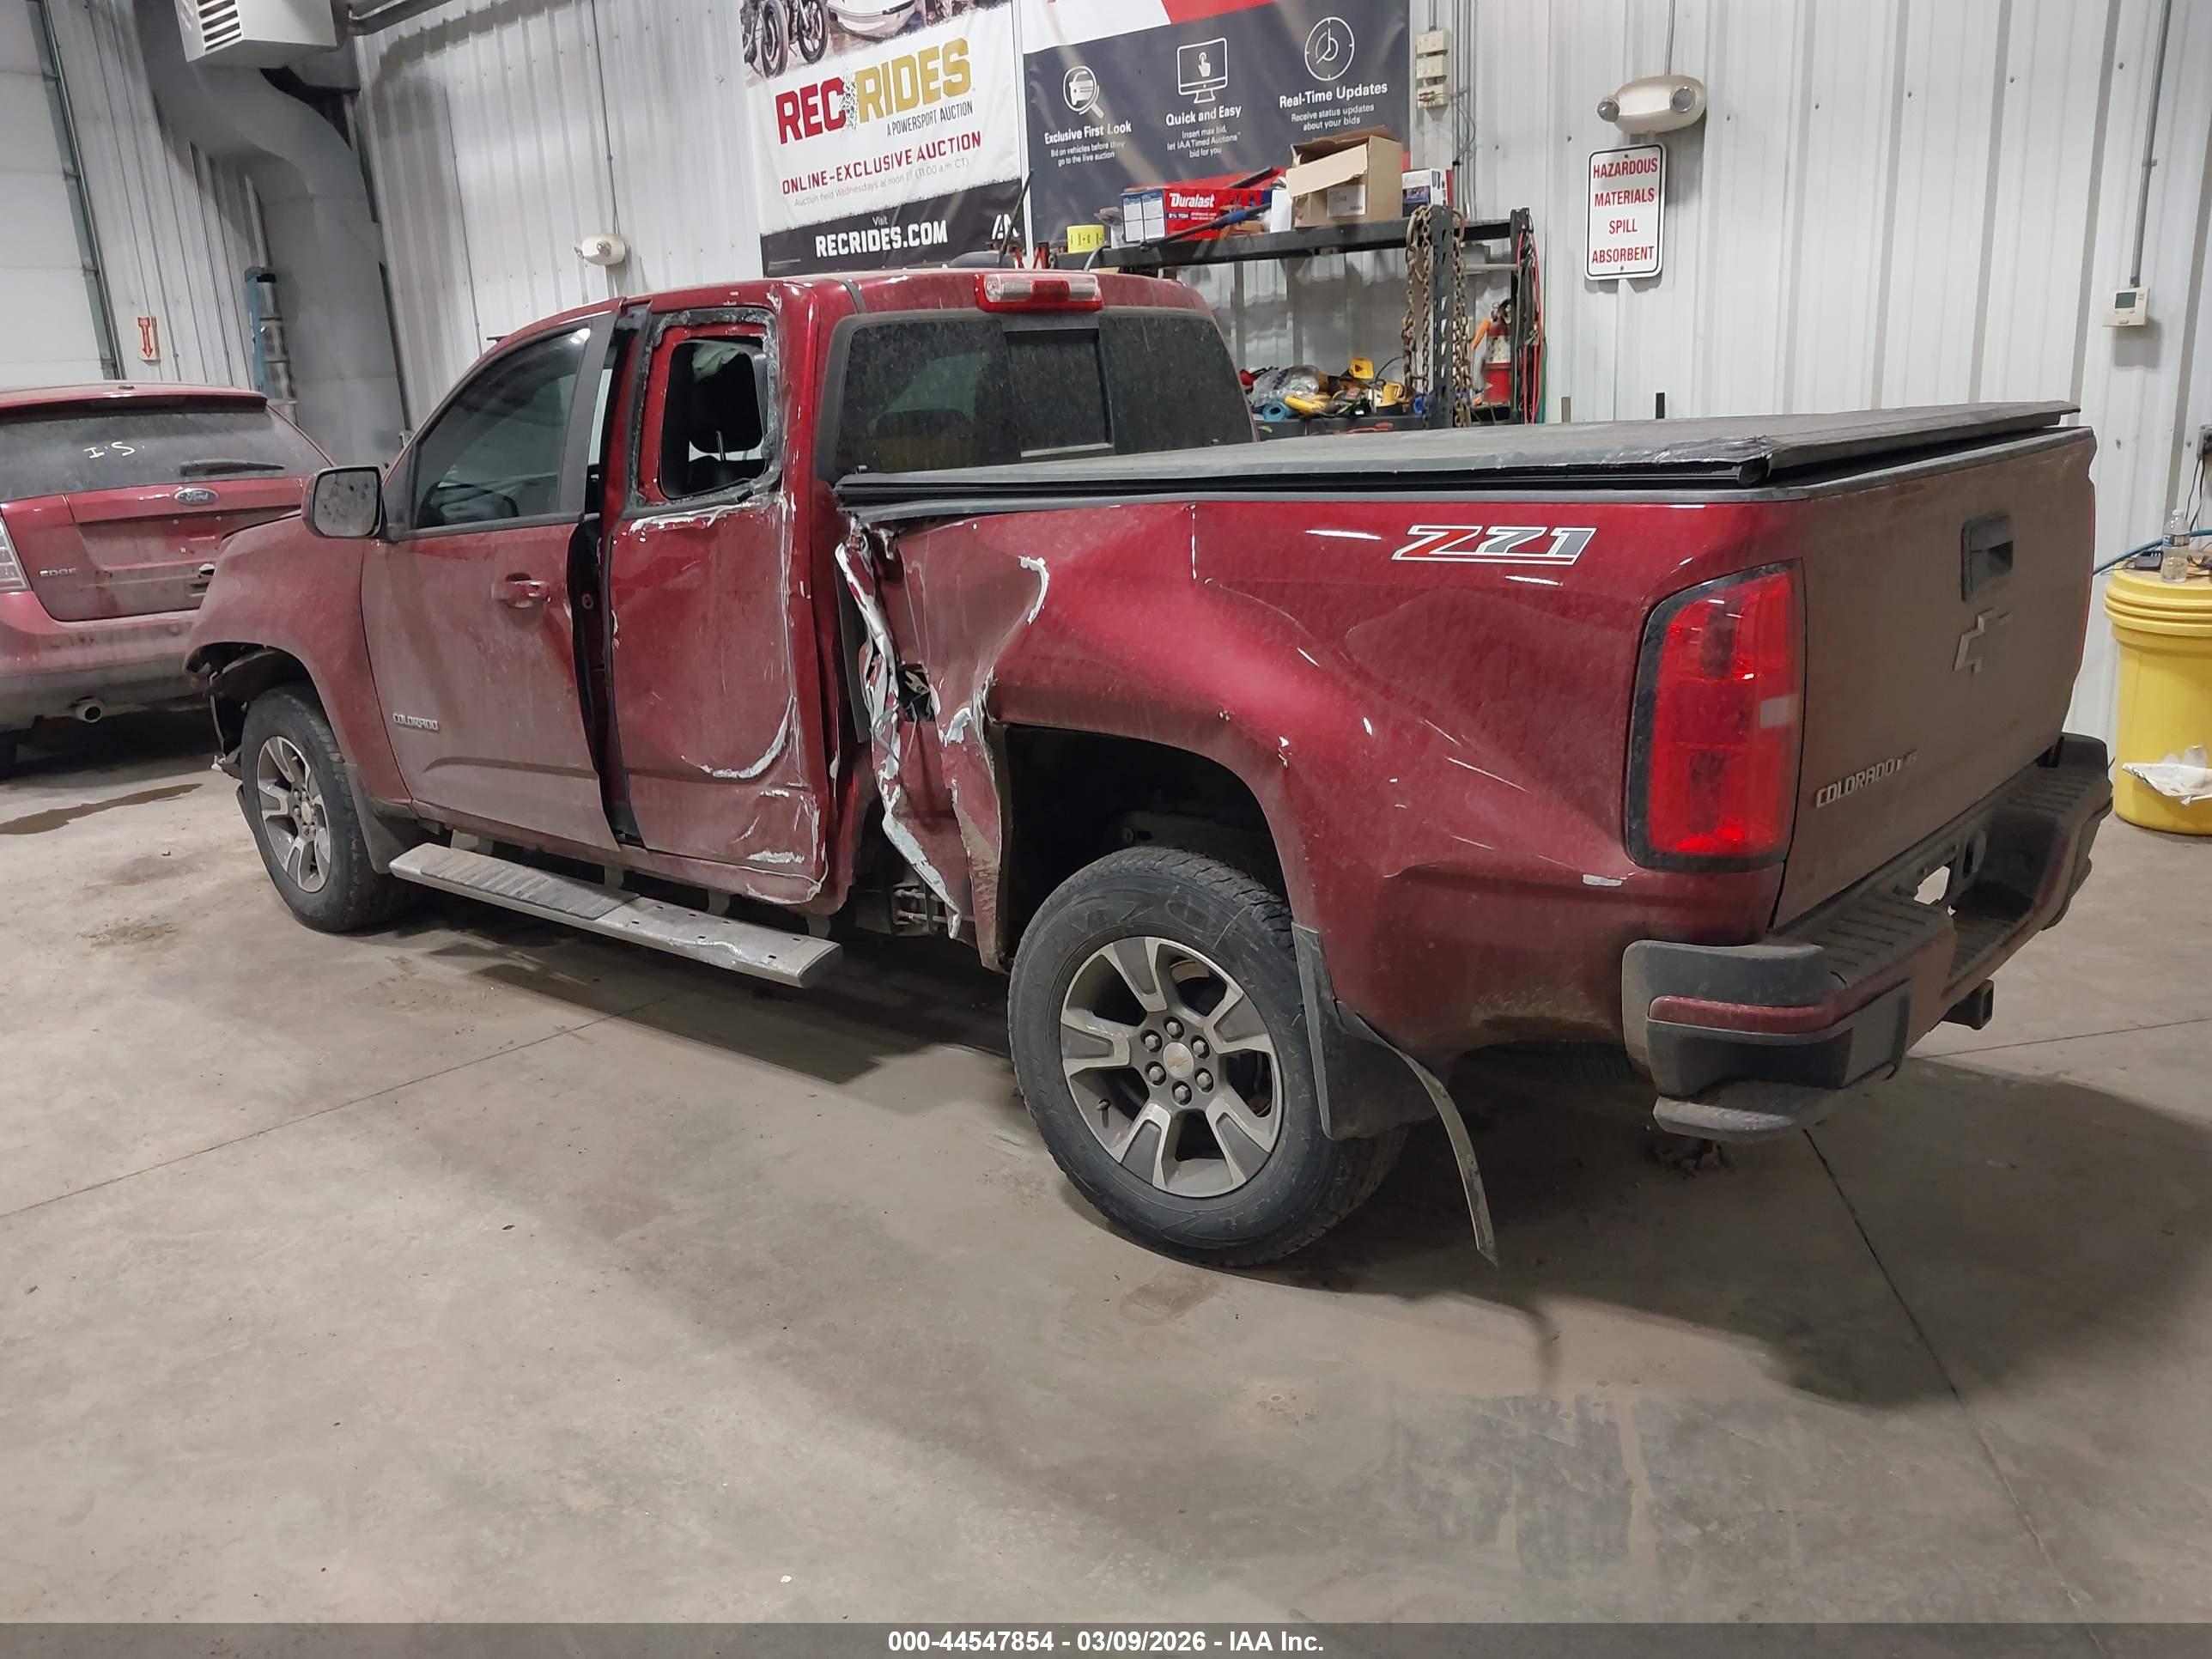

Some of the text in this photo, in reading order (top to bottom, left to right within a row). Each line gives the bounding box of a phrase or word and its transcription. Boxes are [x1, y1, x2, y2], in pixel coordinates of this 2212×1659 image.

[775, 37, 971, 144] REC RIDES
[1279, 82, 1388, 109] Real-Time Updates
[887, 100, 974, 137] A POWERSPORT AUCTION
[1165, 105, 1242, 126] Quick and Easy
[1291, 103, 1375, 122] Receive status updates
[1044, 119, 1132, 145] Exclusive First Look
[1303, 115, 1361, 131] about your bids
[1182, 129, 1200, 139] Insert
[1050, 149, 1059, 158] Bid
[1066, 143, 1091, 155] vehicles
[1091, 142, 1109, 152] before
[1166, 143, 1176, 151] let
[1176, 140, 1191, 149] IAA
[1191, 138, 1210, 148] Timed
[1189, 147, 1222, 158] bid for you
[781, 131, 981, 195] ONLINE-EXCLUSIVE AUCTION
[1058, 158, 1065, 167] go
[1072, 155, 1081, 164] the
[1094, 151, 1115, 161] auction
[1593, 157, 1658, 179] HAZARDOUS
[794, 197, 818, 207] Auction
[820, 191, 834, 201] held
[835, 181, 878, 198] Wednesdays
[888, 176, 904, 187] noon
[1169, 192, 1216, 208] Duralast
[1594, 186, 1656, 208] MATERIALS
[872, 216, 888, 226] Visit
[1608, 218, 1638, 234] SPILL
[815, 220, 948, 258] RECRIDES.COM
[1591, 246, 1656, 264] ABSORBENT
[1391, 525, 1597, 566] Z71
[392, 713, 440, 731] COLORADO
[1815, 758, 1894, 808] COLORADO
